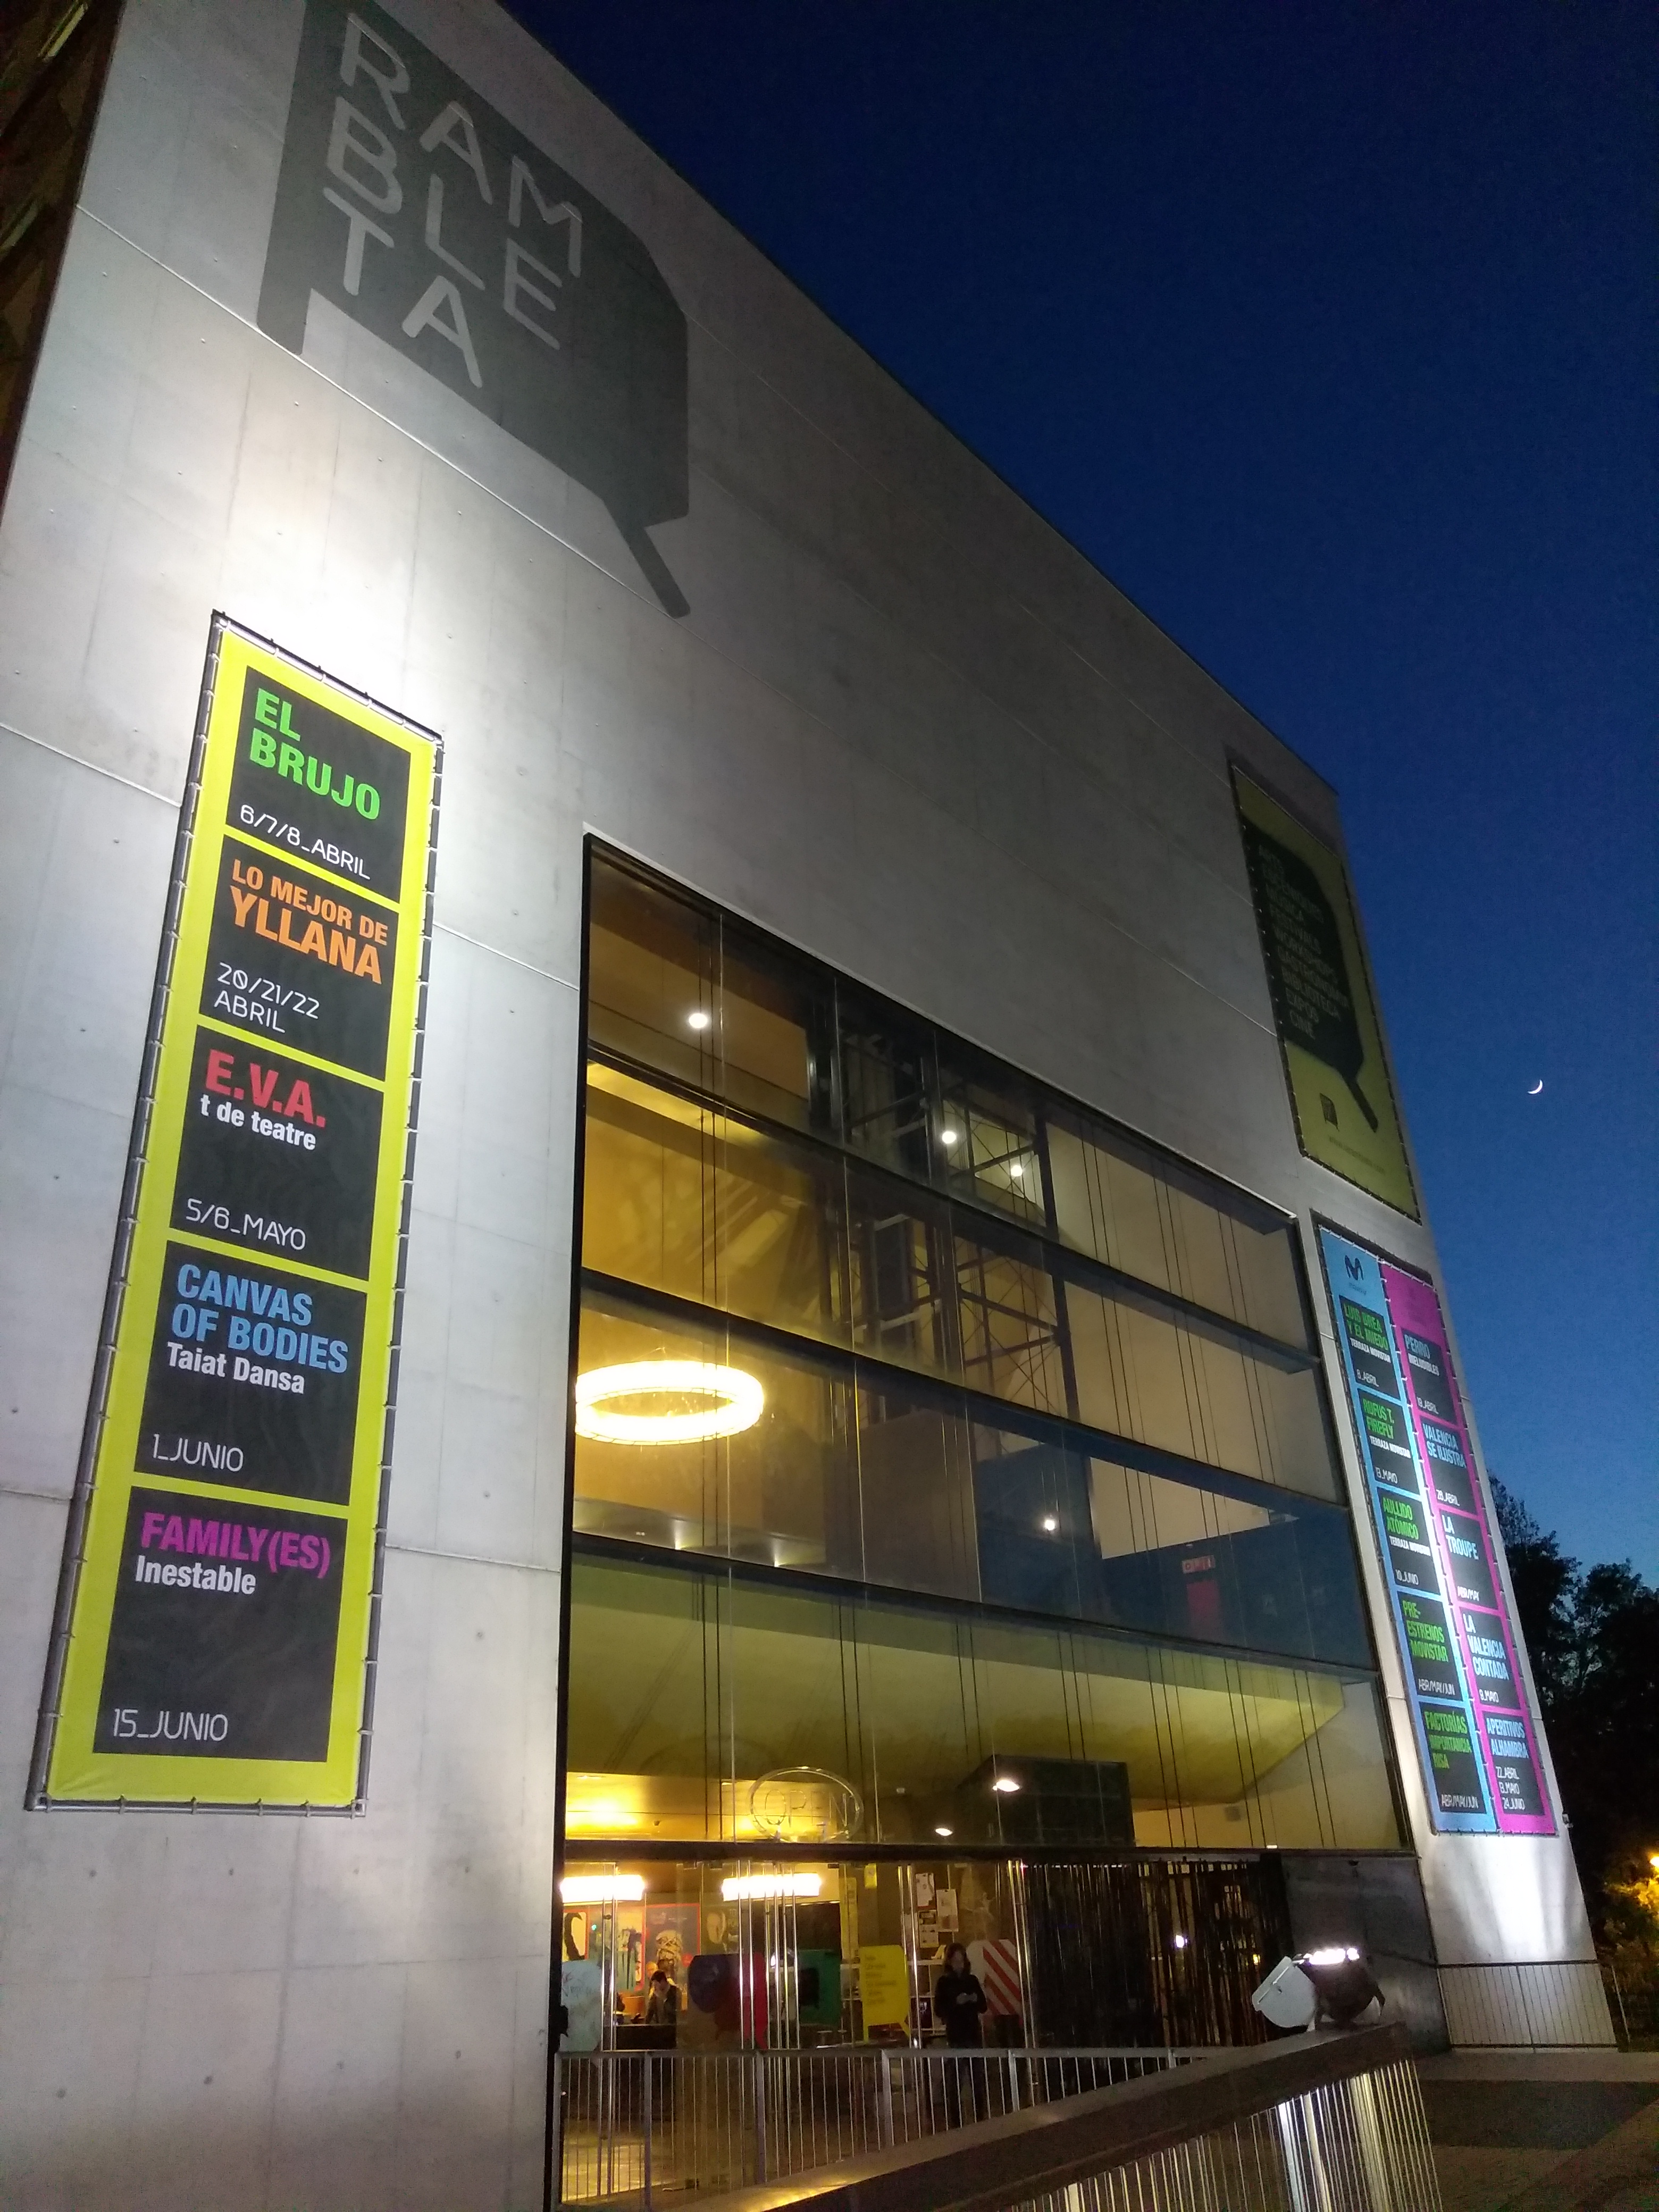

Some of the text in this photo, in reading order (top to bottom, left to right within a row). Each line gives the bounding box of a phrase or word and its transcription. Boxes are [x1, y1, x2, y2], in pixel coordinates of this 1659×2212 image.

[323, 187, 483, 388] TA
[255, 688, 301, 741] EL
[249, 727, 380, 820] BRUJO
[232, 858, 388, 946] LO MEJOR DE
[230, 885, 381, 984] YLLANA
[217, 962, 320, 1019] 20/21/22
[214, 990, 285, 1033] ABRIL
[205, 1049, 326, 1127] E.V.A.
[200, 1094, 316, 1151] t de teatre
[178, 1263, 312, 1326] CANVAS
[172, 1303, 348, 1373] OF BODIES
[1347, 1319, 1353, 1334] Y
[1354, 1324, 1364, 1339] EL
[167, 1342, 305, 1394] Taiat Dansa
[1366, 1417, 1394, 1439] FIREFLY
[1422, 1423, 1459, 1450] VALENCIA
[1427, 1440, 1437, 1458] SE
[1383, 1497, 1413, 1521] AULLIDO
[1442, 1514, 1455, 1534] LA
[140, 1512, 330, 1579] FAMILY(ES)
[1445, 1535, 1479, 1560] TROUPE
[135, 1555, 256, 1595] Inestable
[1402, 1600, 1421, 1619] PRE-
[1463, 1613, 1476, 1633] LA
[1406, 1620, 1445, 1643] ESTRENOS
[1410, 1639, 1449, 1662] MOVISTAR
[1467, 1635, 1506, 1660] VALENCIA
[1472, 1656, 1510, 1680] CONTADA
[1424, 1711, 1468, 1735] FACTORÍAS
[1486, 1717, 1526, 1738] APERITIVOS
[1490, 1739, 1529, 1758] ALHAMBRA
[765, 1789, 848, 1828] OPEN
